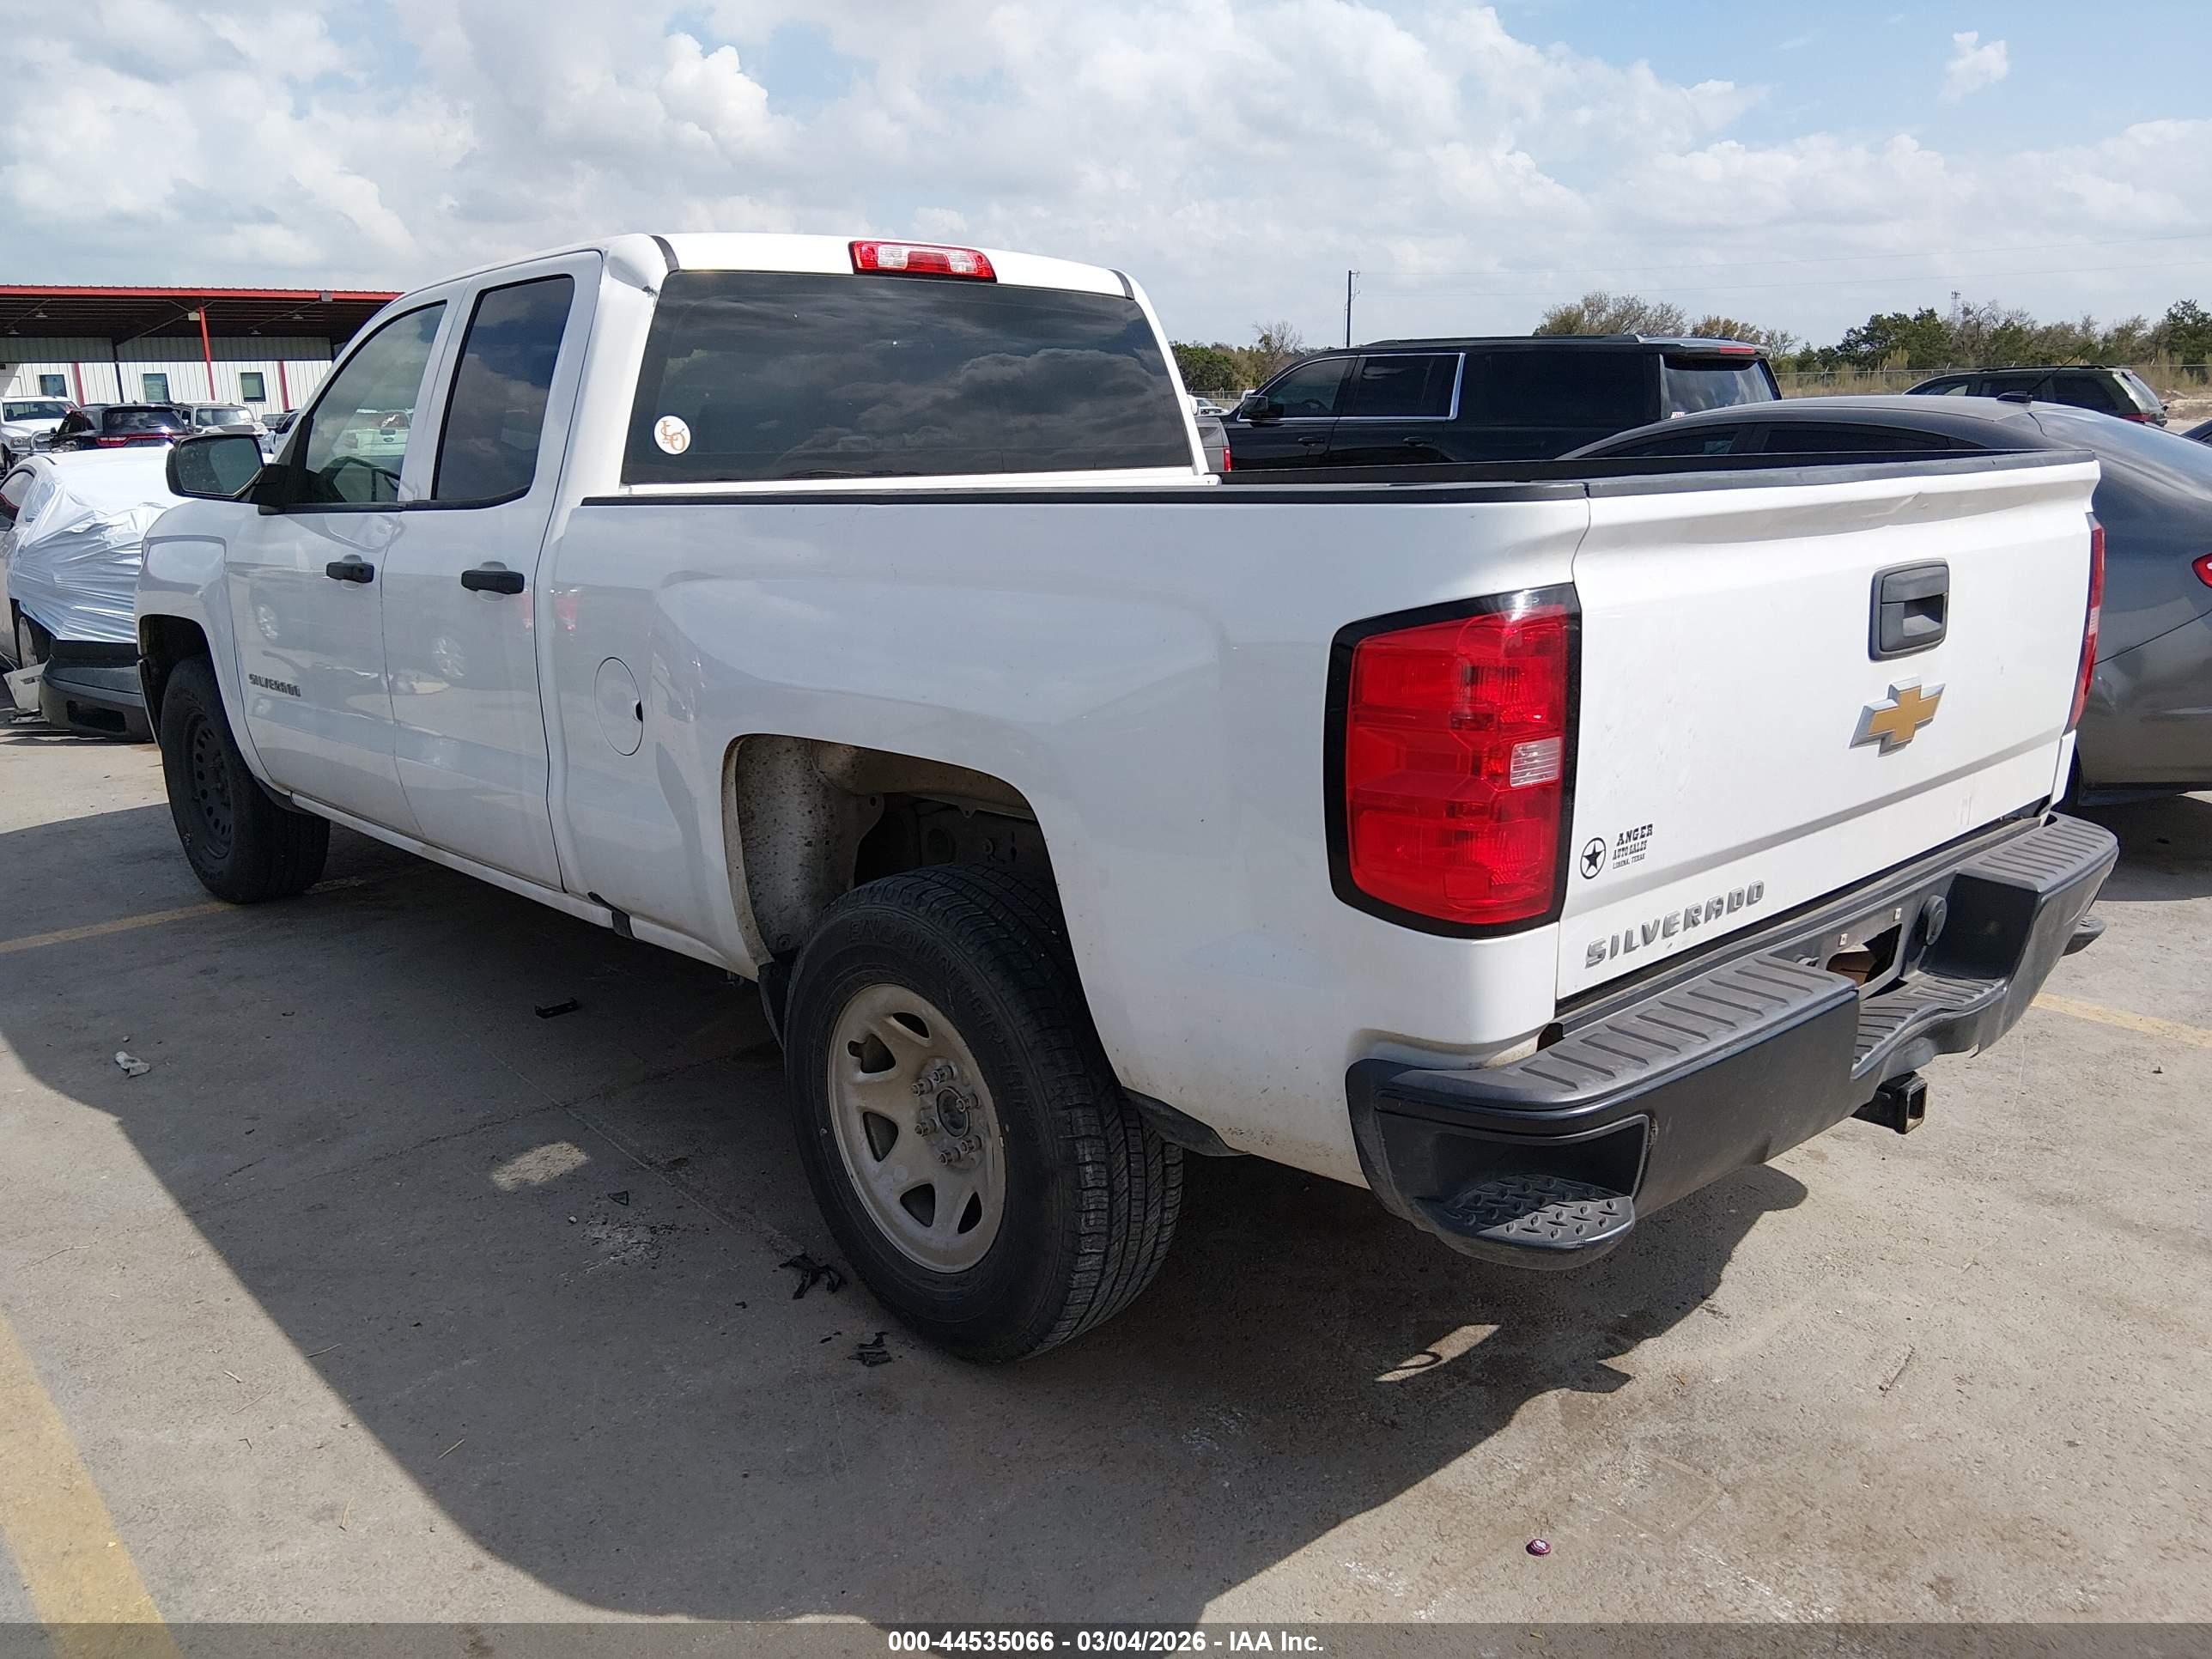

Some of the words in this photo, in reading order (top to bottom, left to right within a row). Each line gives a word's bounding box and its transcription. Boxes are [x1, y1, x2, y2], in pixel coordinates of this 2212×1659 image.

[1616, 823, 1653, 847] ANGER
[1613, 849, 1628, 860] AUTO
[1629, 841, 1647, 855] SALES
[1585, 880, 1764, 969] SILVERADO
